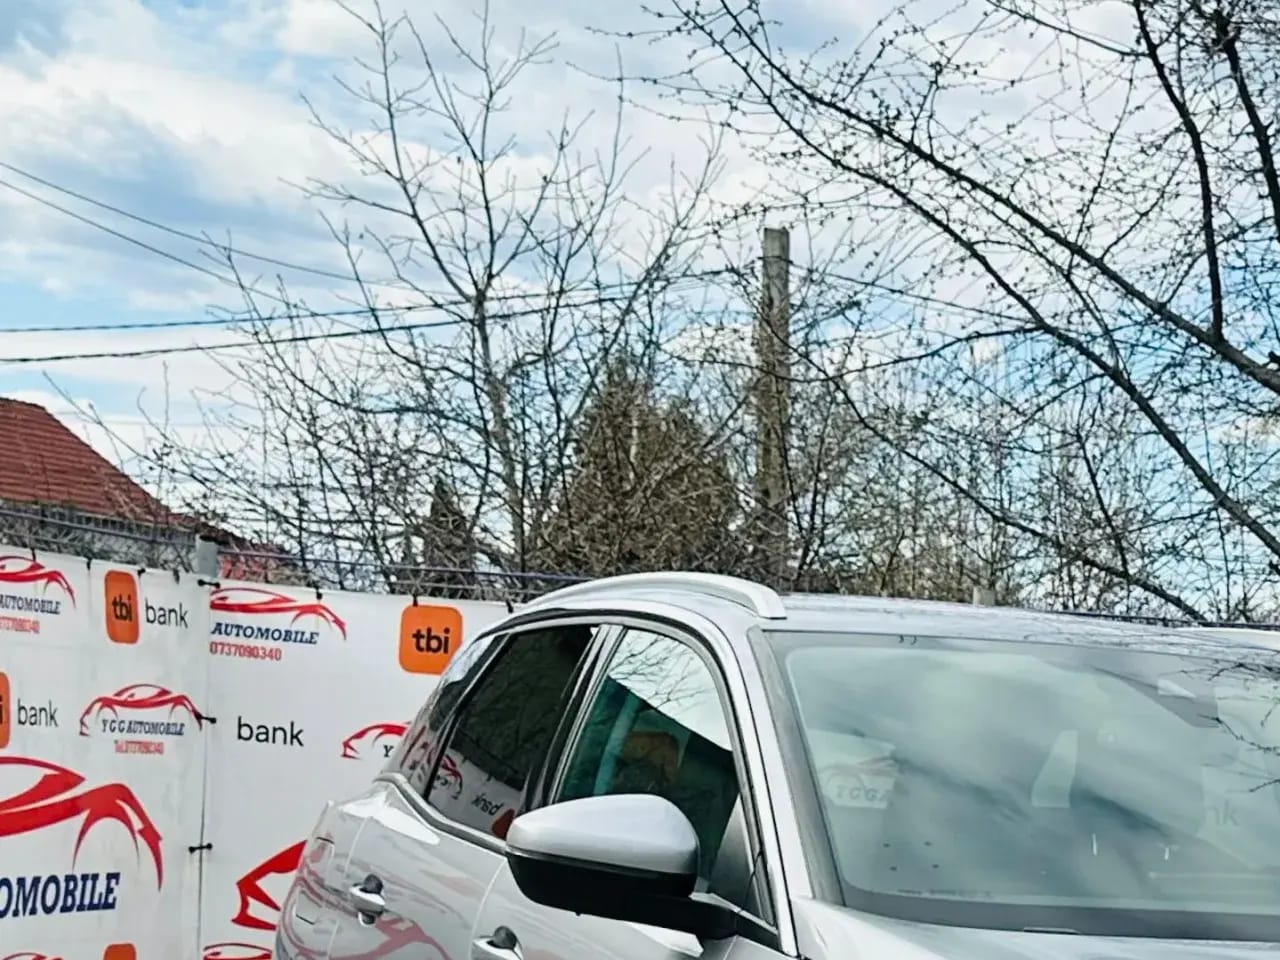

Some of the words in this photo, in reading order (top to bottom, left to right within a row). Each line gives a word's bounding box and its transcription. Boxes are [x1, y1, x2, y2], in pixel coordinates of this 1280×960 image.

[112, 595, 133, 622] tbi
[145, 597, 189, 629] bank
[211, 622, 319, 645] AUTOMOBILE
[412, 627, 451, 654] tbi
[210, 642, 282, 661] 0737090340
[18, 698, 59, 728] bank
[126, 720, 186, 736] AUTOMOBILE
[238, 716, 304, 748] bank
